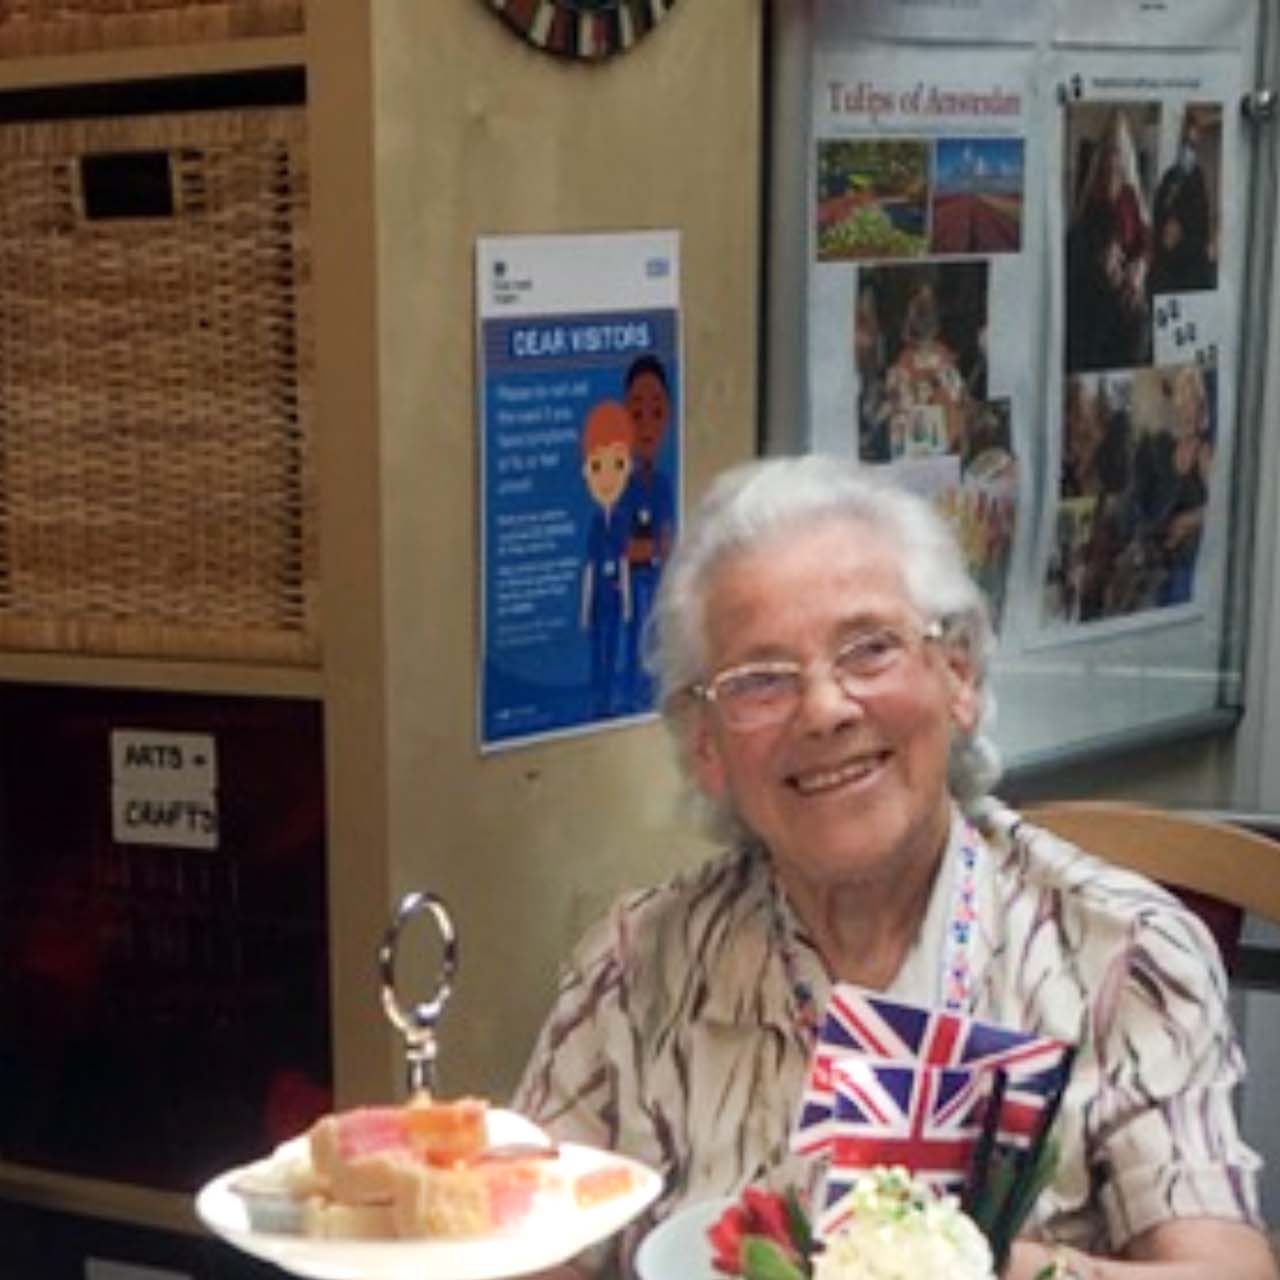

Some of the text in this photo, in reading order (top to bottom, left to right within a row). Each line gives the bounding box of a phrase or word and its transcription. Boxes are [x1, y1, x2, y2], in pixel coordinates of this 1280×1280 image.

[828, 81, 892, 122] Tulips
[899, 80, 924, 114] of
[512, 321, 651, 355] DEAR VISITORS
[125, 744, 181, 770] ARTS
